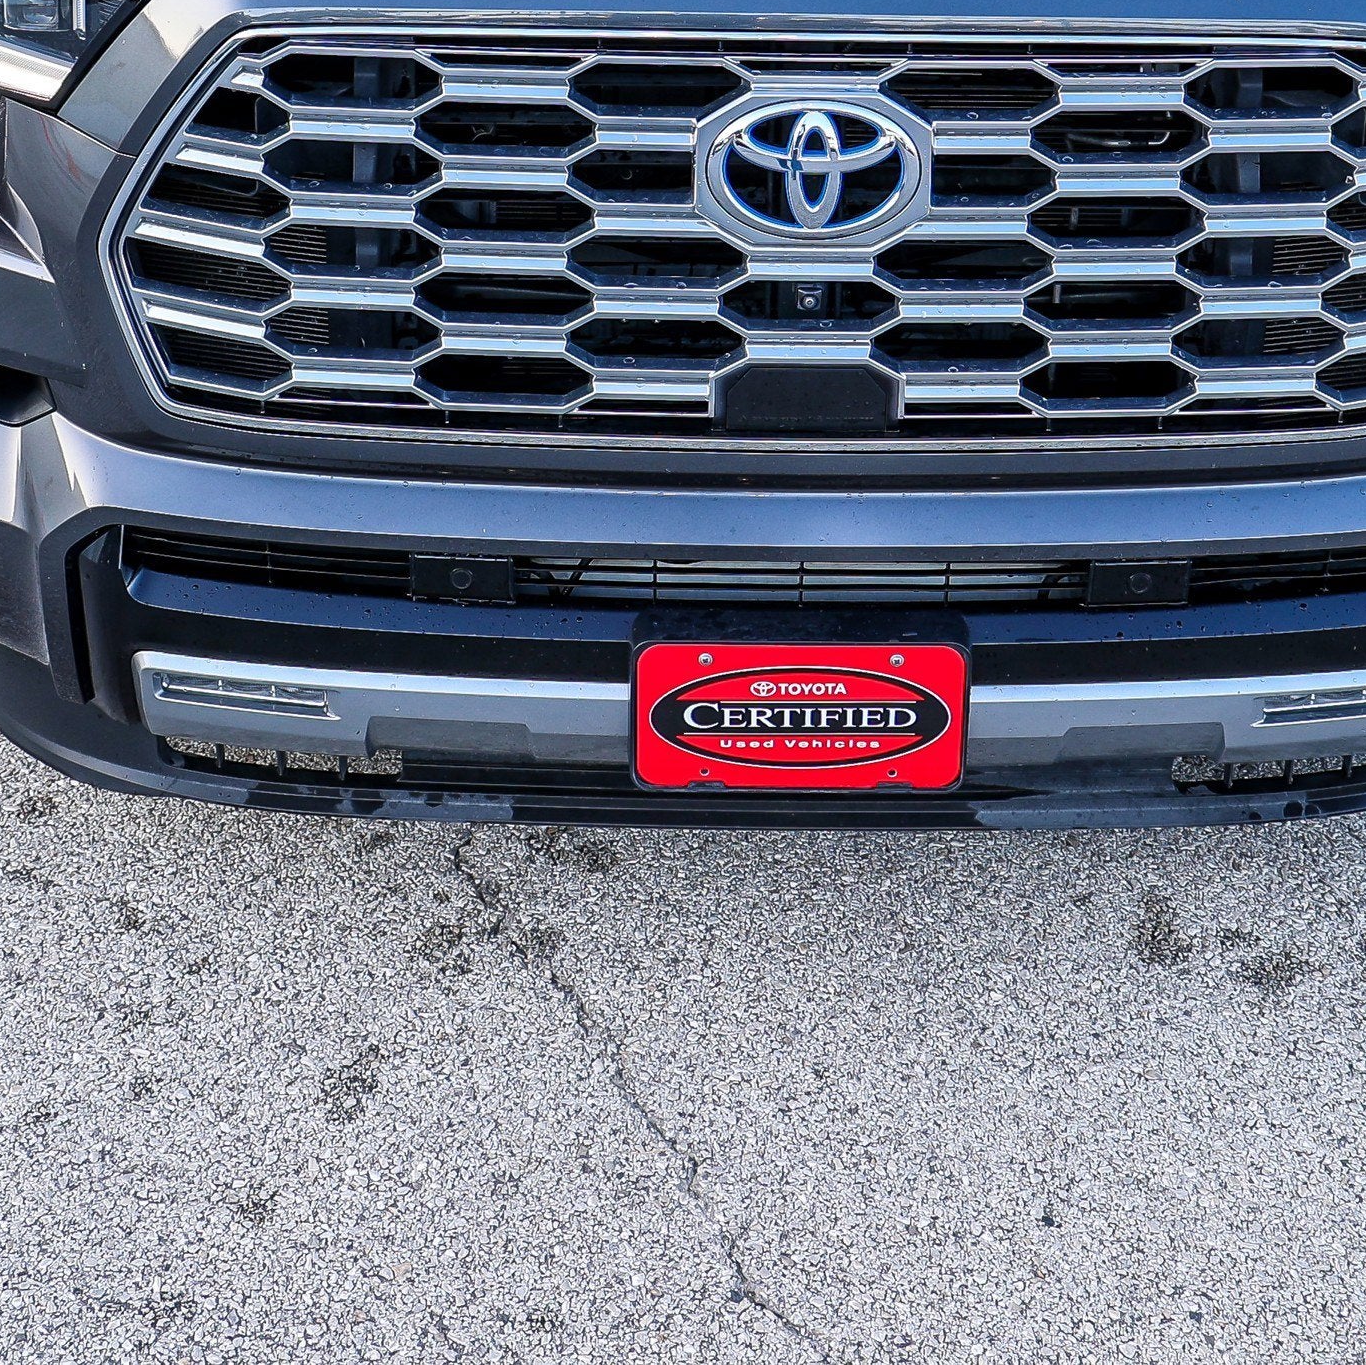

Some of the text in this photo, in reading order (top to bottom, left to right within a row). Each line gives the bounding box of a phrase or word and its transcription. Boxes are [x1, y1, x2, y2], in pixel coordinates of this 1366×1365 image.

[778, 682, 847, 695] TOYOTA
[683, 702, 917, 729] CERTIFIED
[720, 739, 880, 748] Used Vehicles
